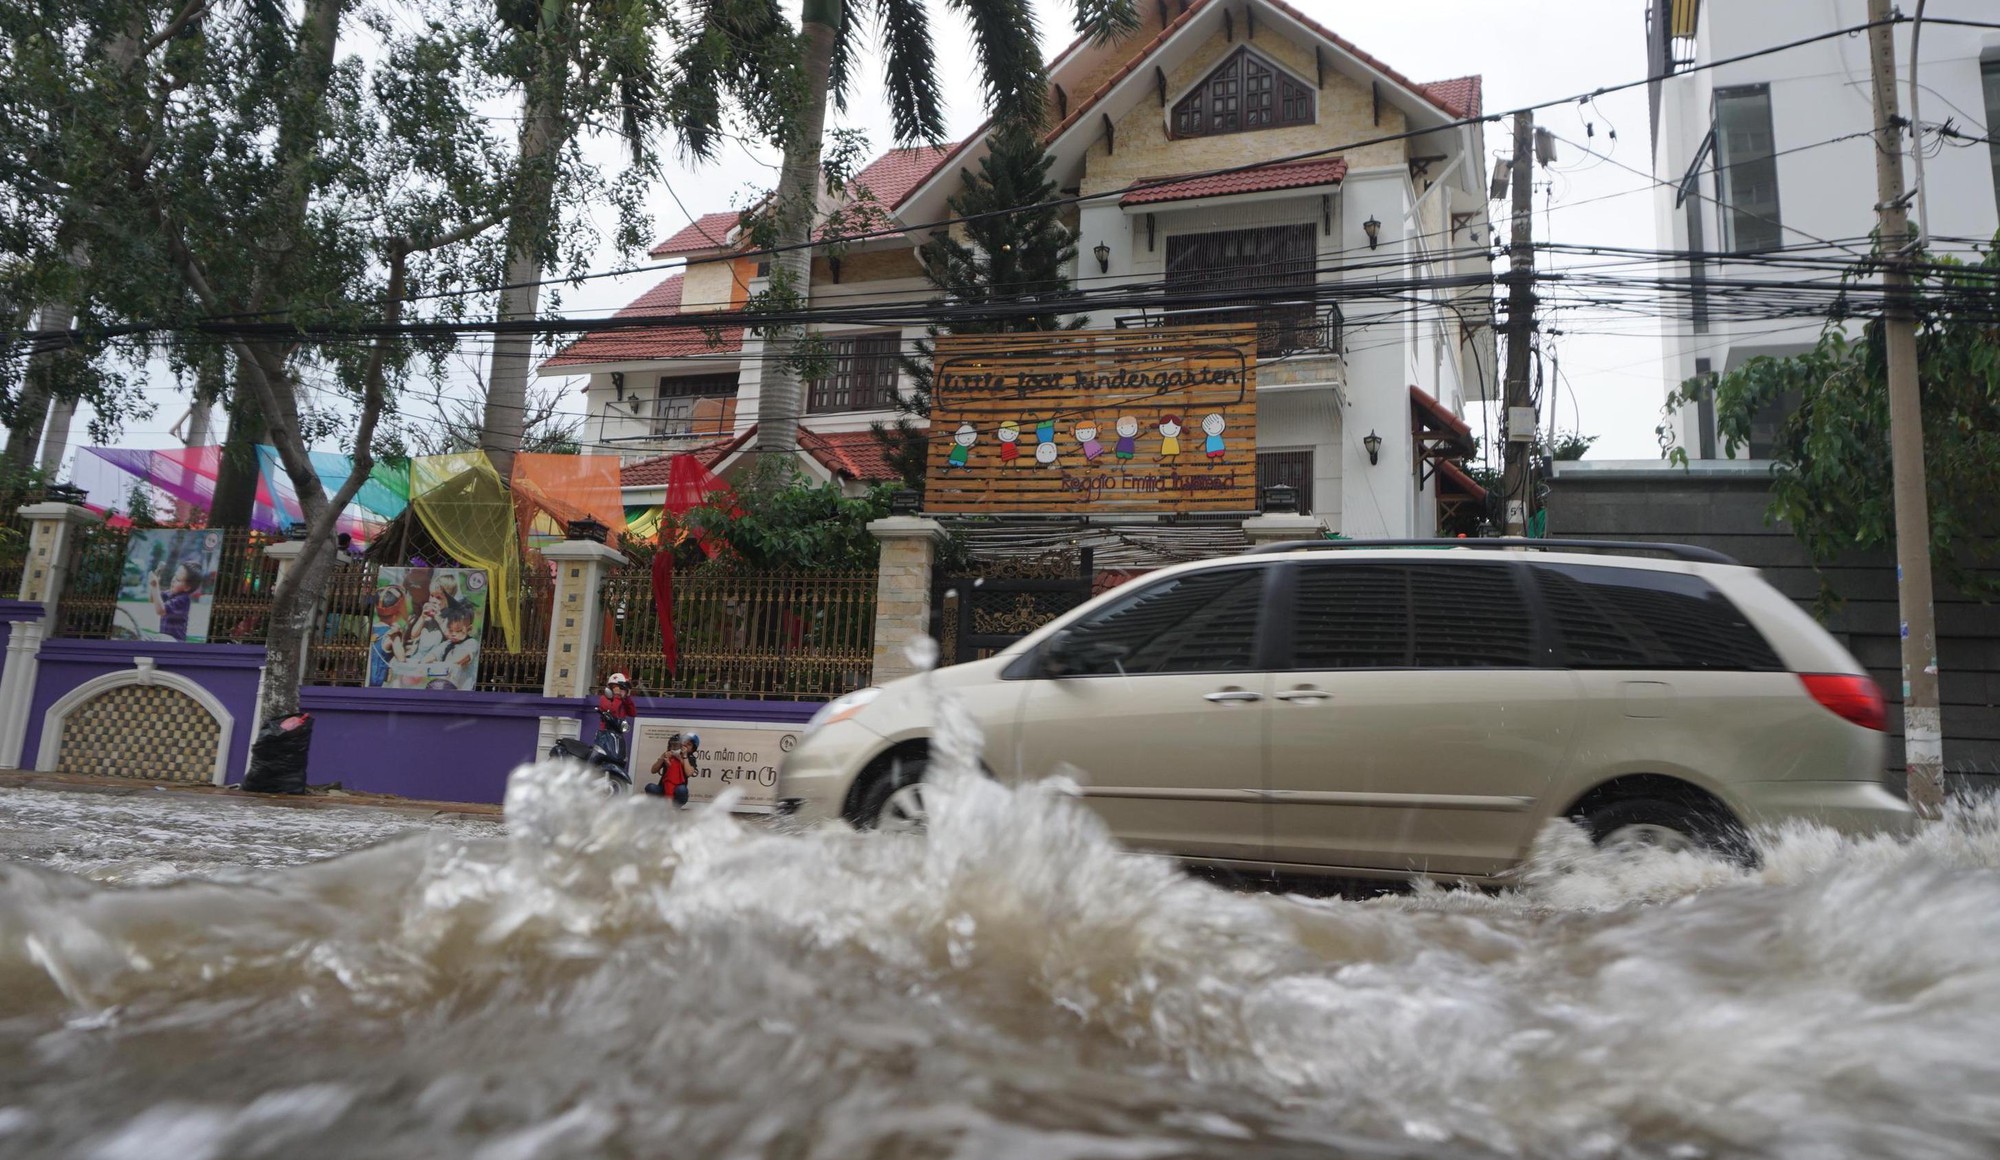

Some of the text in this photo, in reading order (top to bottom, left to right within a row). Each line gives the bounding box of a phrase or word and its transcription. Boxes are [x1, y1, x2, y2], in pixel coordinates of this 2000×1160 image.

[941, 368, 1239, 399] little foot kindergarten
[1061, 470, 1116, 503] Reggio
[1122, 472, 1166, 492] Emilia
